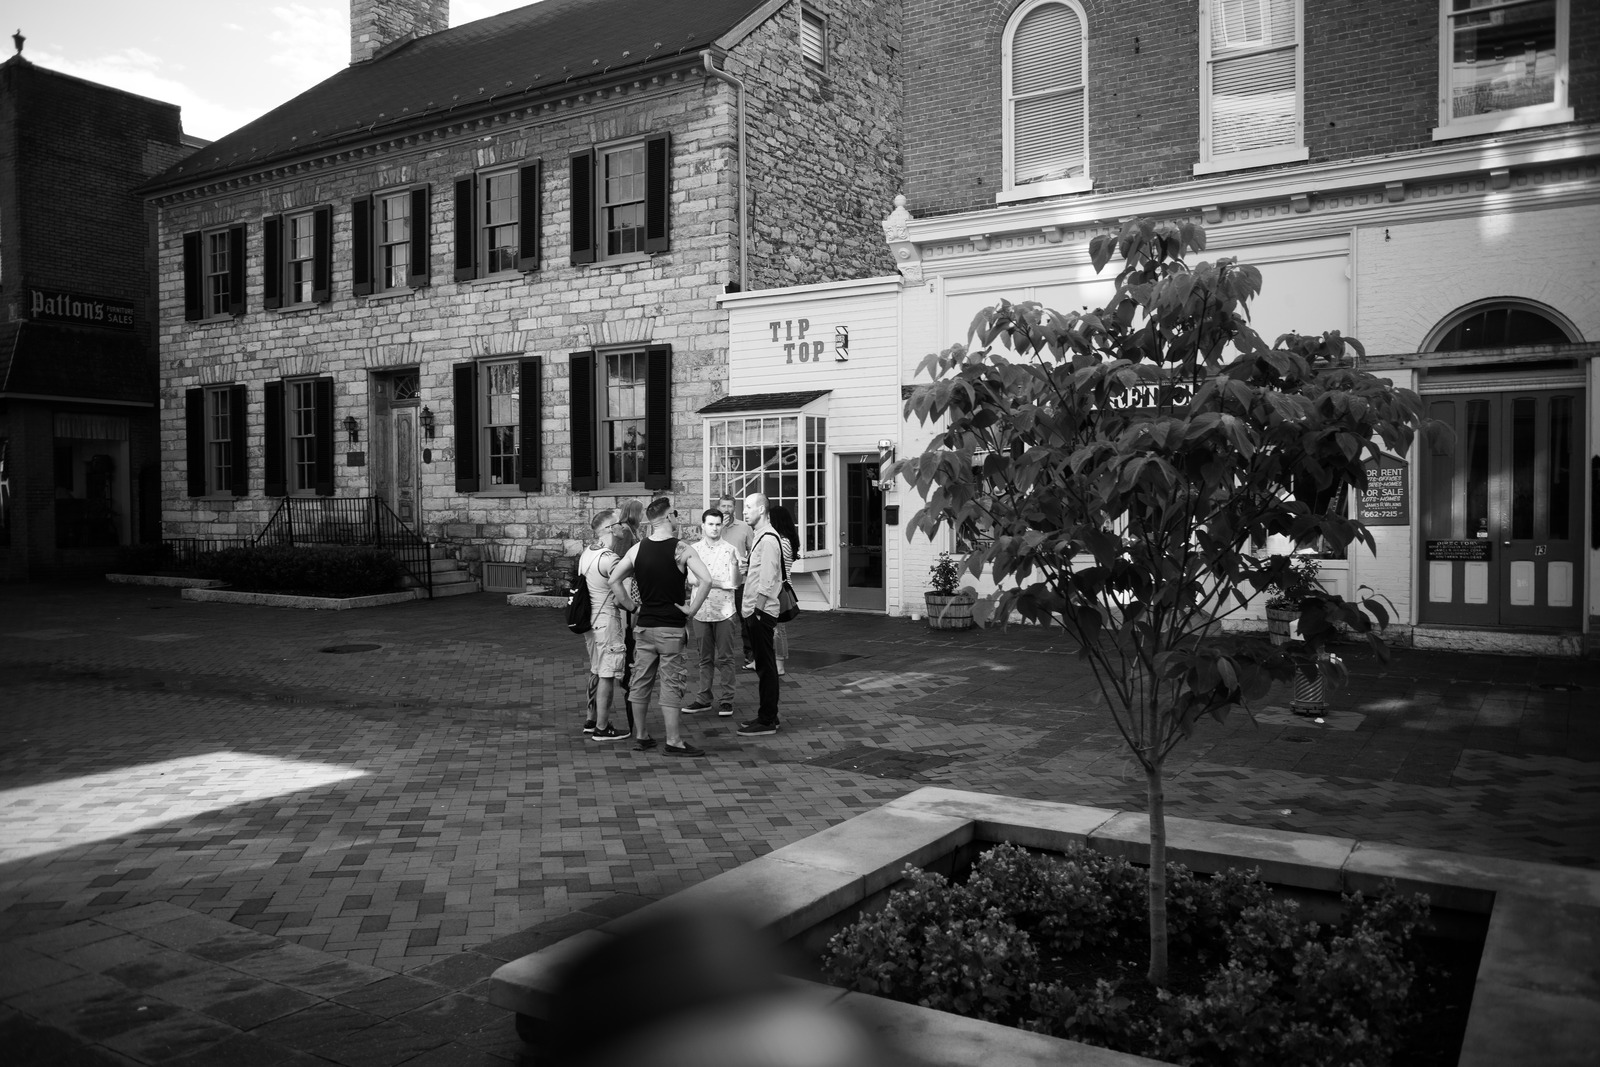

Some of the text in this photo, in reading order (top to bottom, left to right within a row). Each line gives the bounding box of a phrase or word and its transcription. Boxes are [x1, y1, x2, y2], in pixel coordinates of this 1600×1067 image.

[31, 290, 104, 320] Patton's
[106, 305, 134, 315] FURNITURE
[107, 313, 133, 324] SALES
[769, 318, 810, 342] TIP
[783, 340, 825, 365] TOP
[860, 454, 868, 463] 17
[1366, 468, 1403, 477] OR RENT
[1381, 488, 1404, 496] SALE
[1535, 546, 1546, 555] 13
